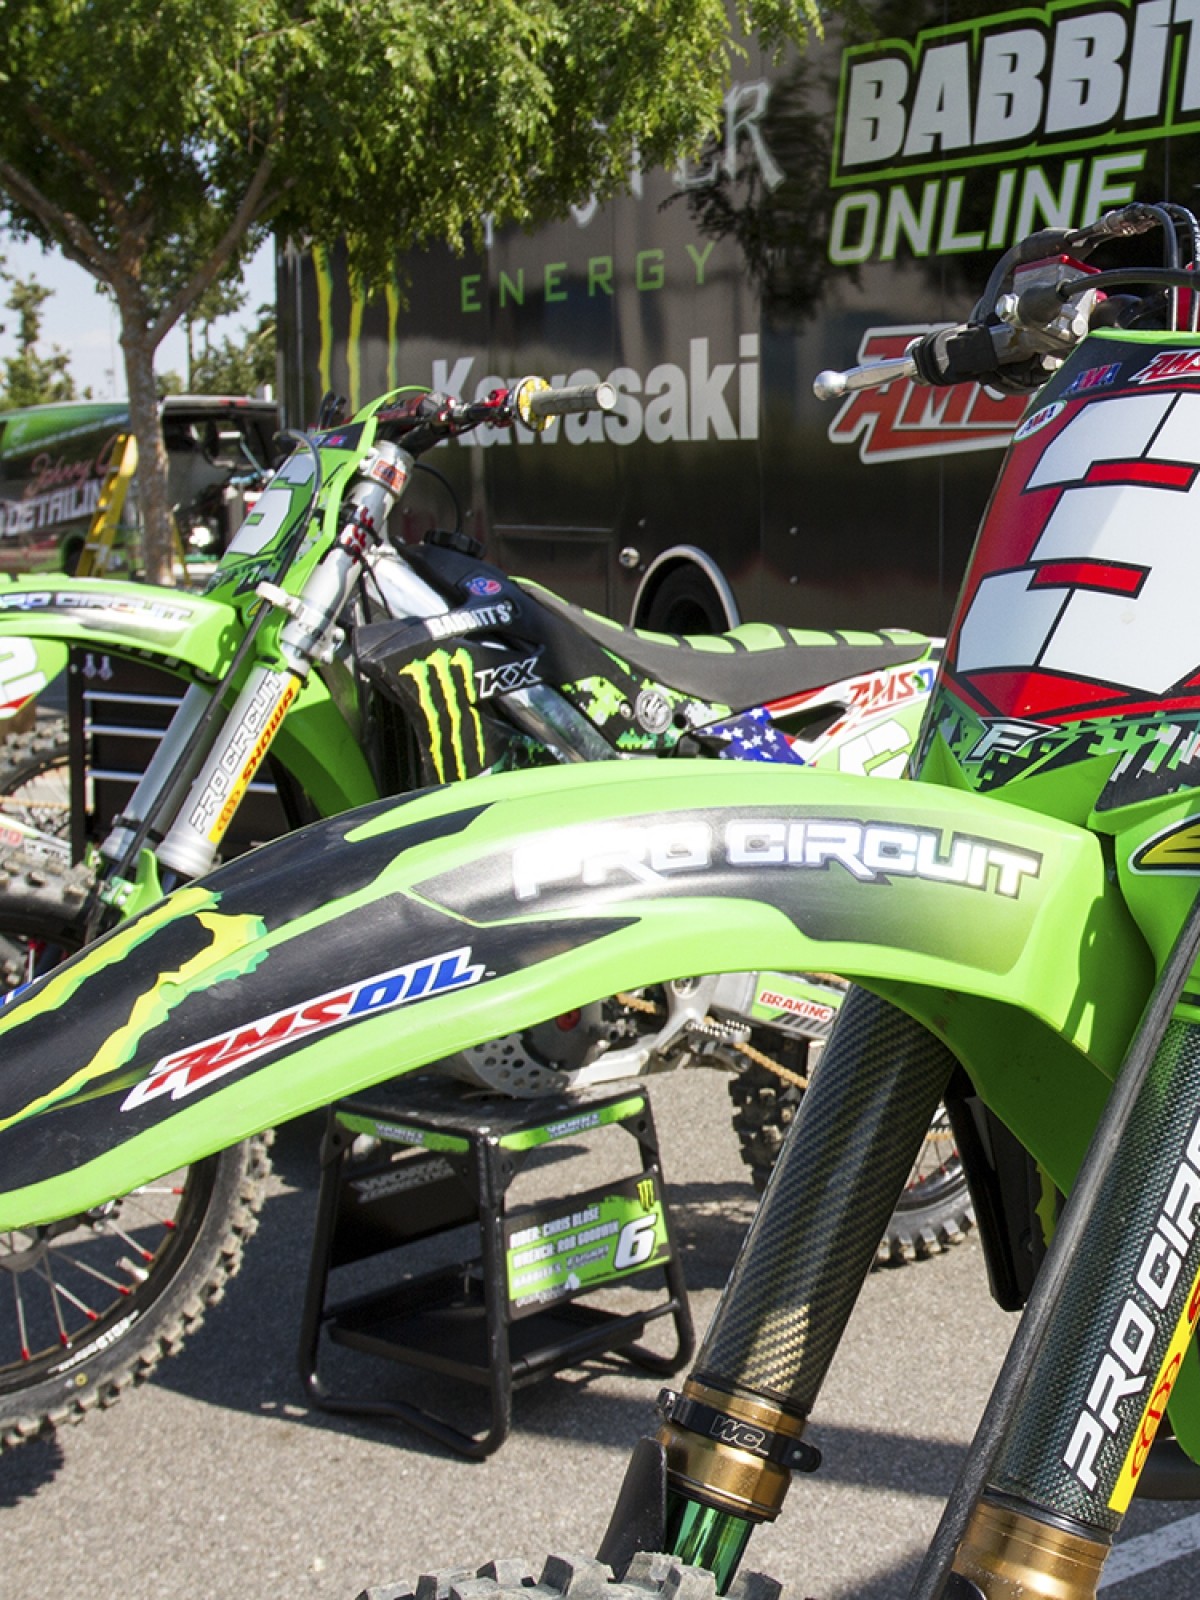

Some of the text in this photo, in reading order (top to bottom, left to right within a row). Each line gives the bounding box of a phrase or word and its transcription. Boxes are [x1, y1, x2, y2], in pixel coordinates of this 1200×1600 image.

[829, 152, 1147, 265] ONLINE
[461, 240, 716, 314] ENERGY
[431, 333, 760, 447] Kawasaki
[475, 657, 541, 699] KX
[512, 820, 1042, 901] PRO CIRCUIT
[121, 947, 486, 1112] AMSOIL
[760, 991, 830, 1020] BRAKING
[615, 1213, 658, 1270] 6
[1063, 1298, 1156, 1491] PRO
